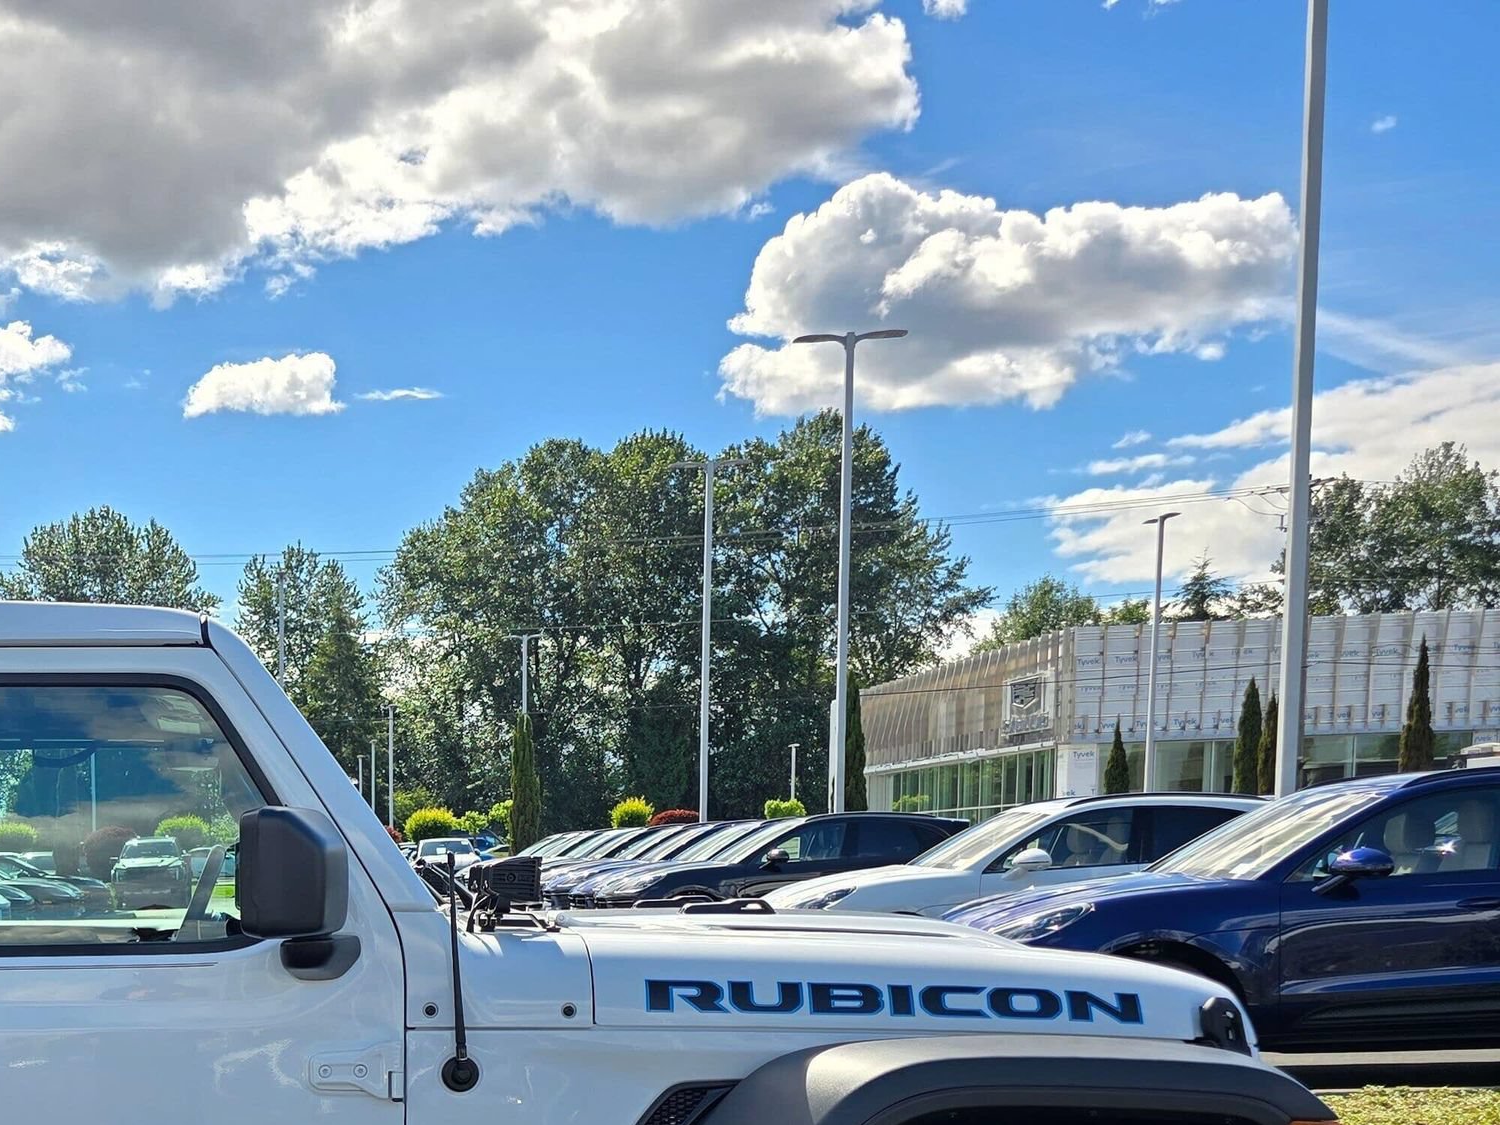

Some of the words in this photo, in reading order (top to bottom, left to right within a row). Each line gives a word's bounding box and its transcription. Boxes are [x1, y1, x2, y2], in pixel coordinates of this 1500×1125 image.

[1077, 657, 1100, 666] Tyvek
[1073, 751, 1095, 759] Tyvek
[644, 979, 1144, 1025] RUBICON
